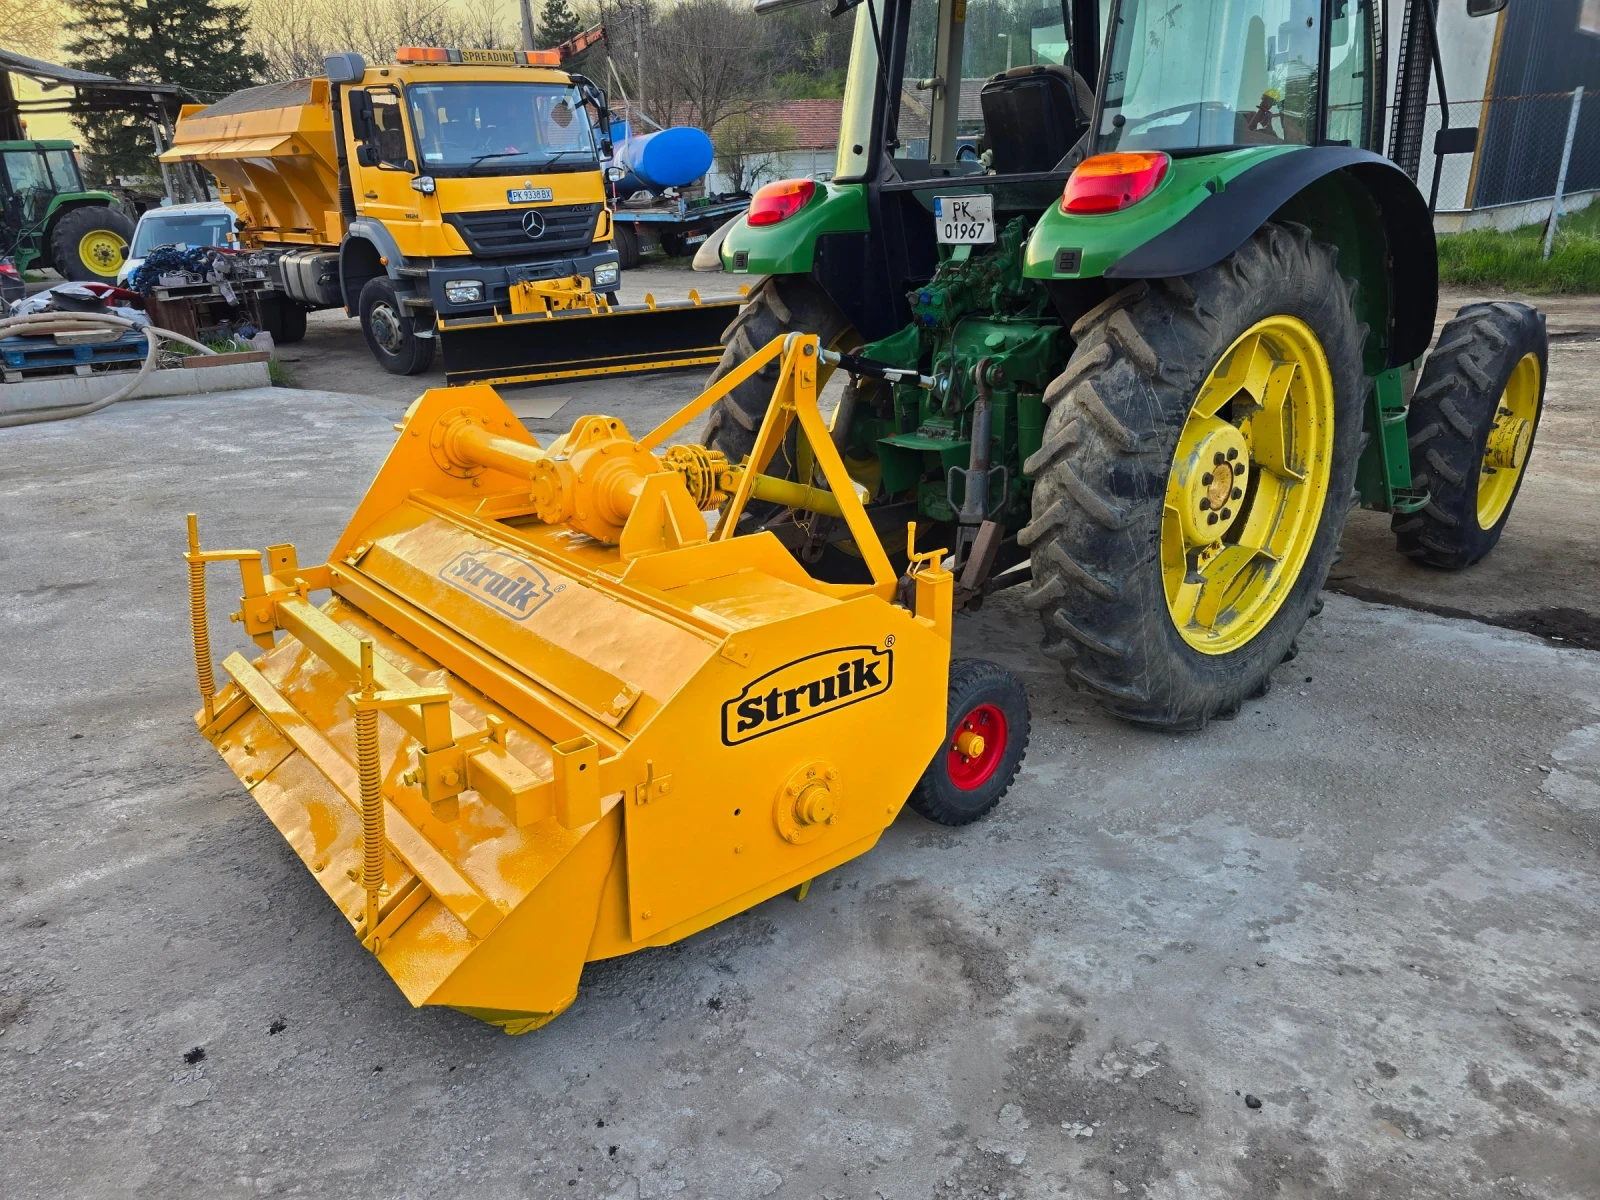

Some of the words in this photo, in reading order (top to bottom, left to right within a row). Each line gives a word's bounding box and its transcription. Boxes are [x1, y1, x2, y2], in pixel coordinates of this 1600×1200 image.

[462, 51, 515, 62] SPREADING
[512, 191, 523, 200] PK
[524, 190, 541, 199] 9338
[541, 189, 551, 198] BX
[952, 201, 970, 218] PK
[945, 222, 985, 239] 01967
